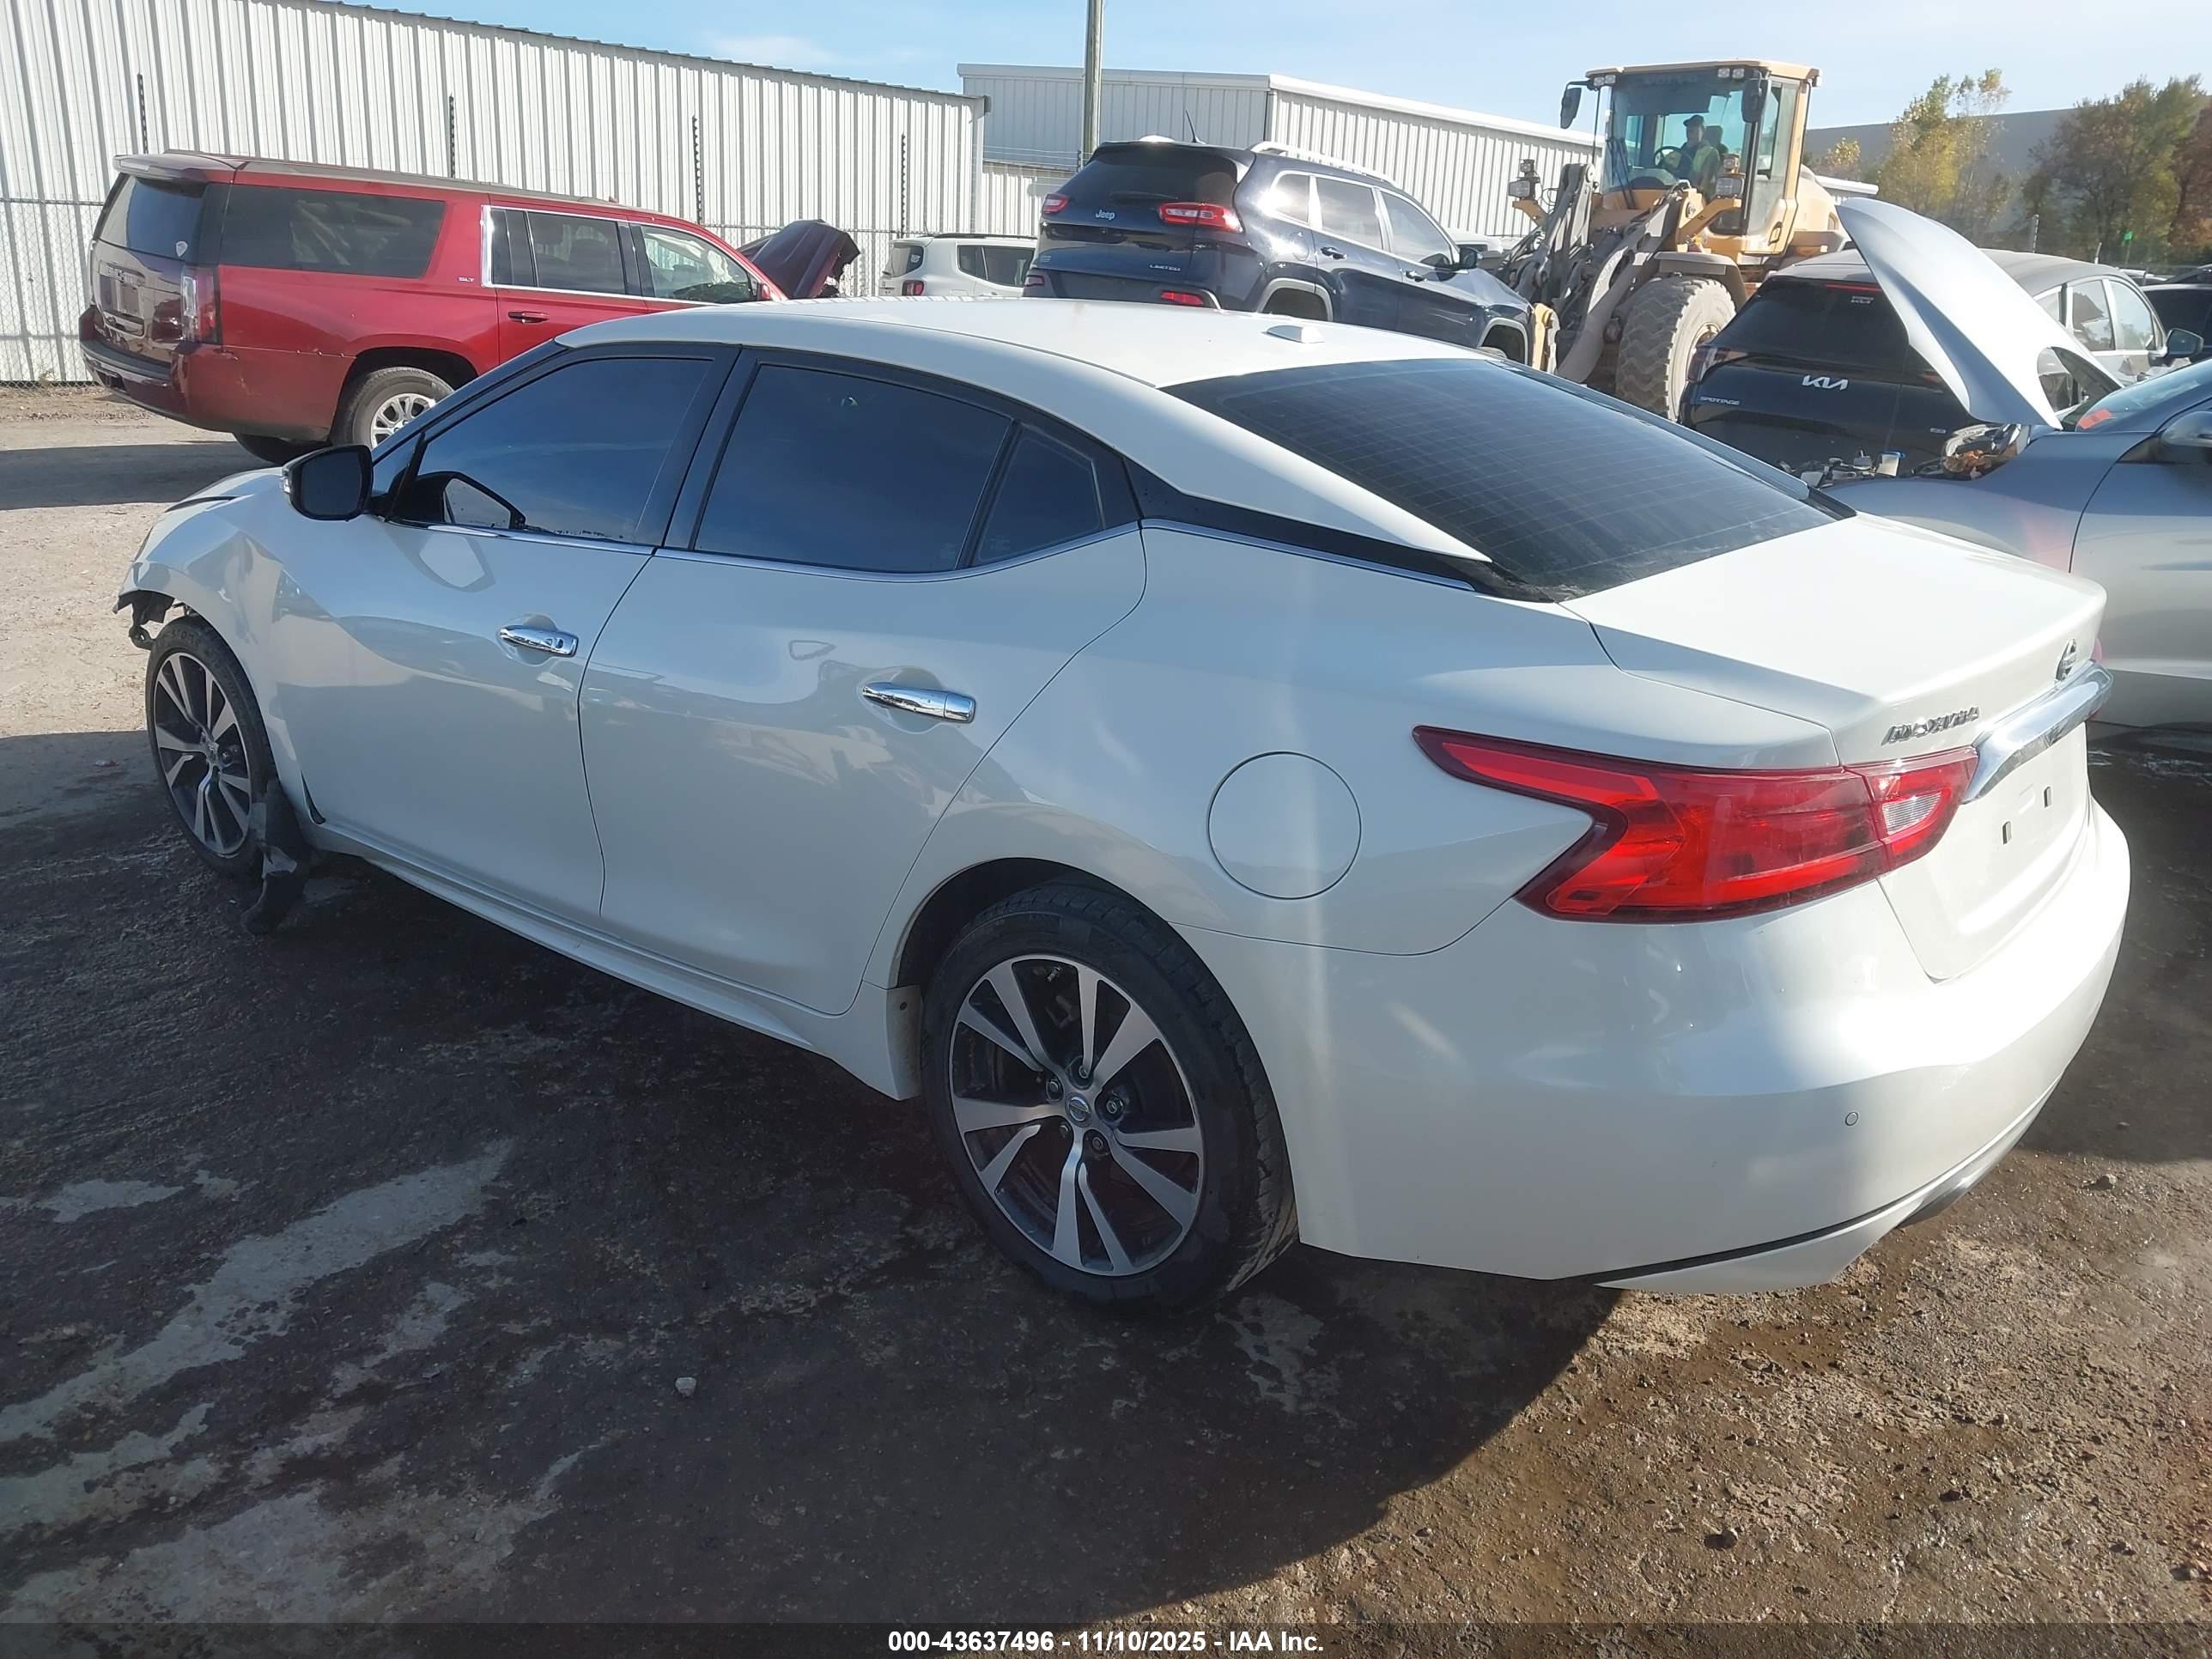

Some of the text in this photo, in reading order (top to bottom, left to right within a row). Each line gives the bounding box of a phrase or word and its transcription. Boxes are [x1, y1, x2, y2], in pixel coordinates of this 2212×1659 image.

[1095, 209, 1115, 221] Jeep
[1802, 374, 1849, 391] KIA
[1700, 396, 1740, 405] SPORTAGE
[1881, 707, 1978, 745] MAXIMA
